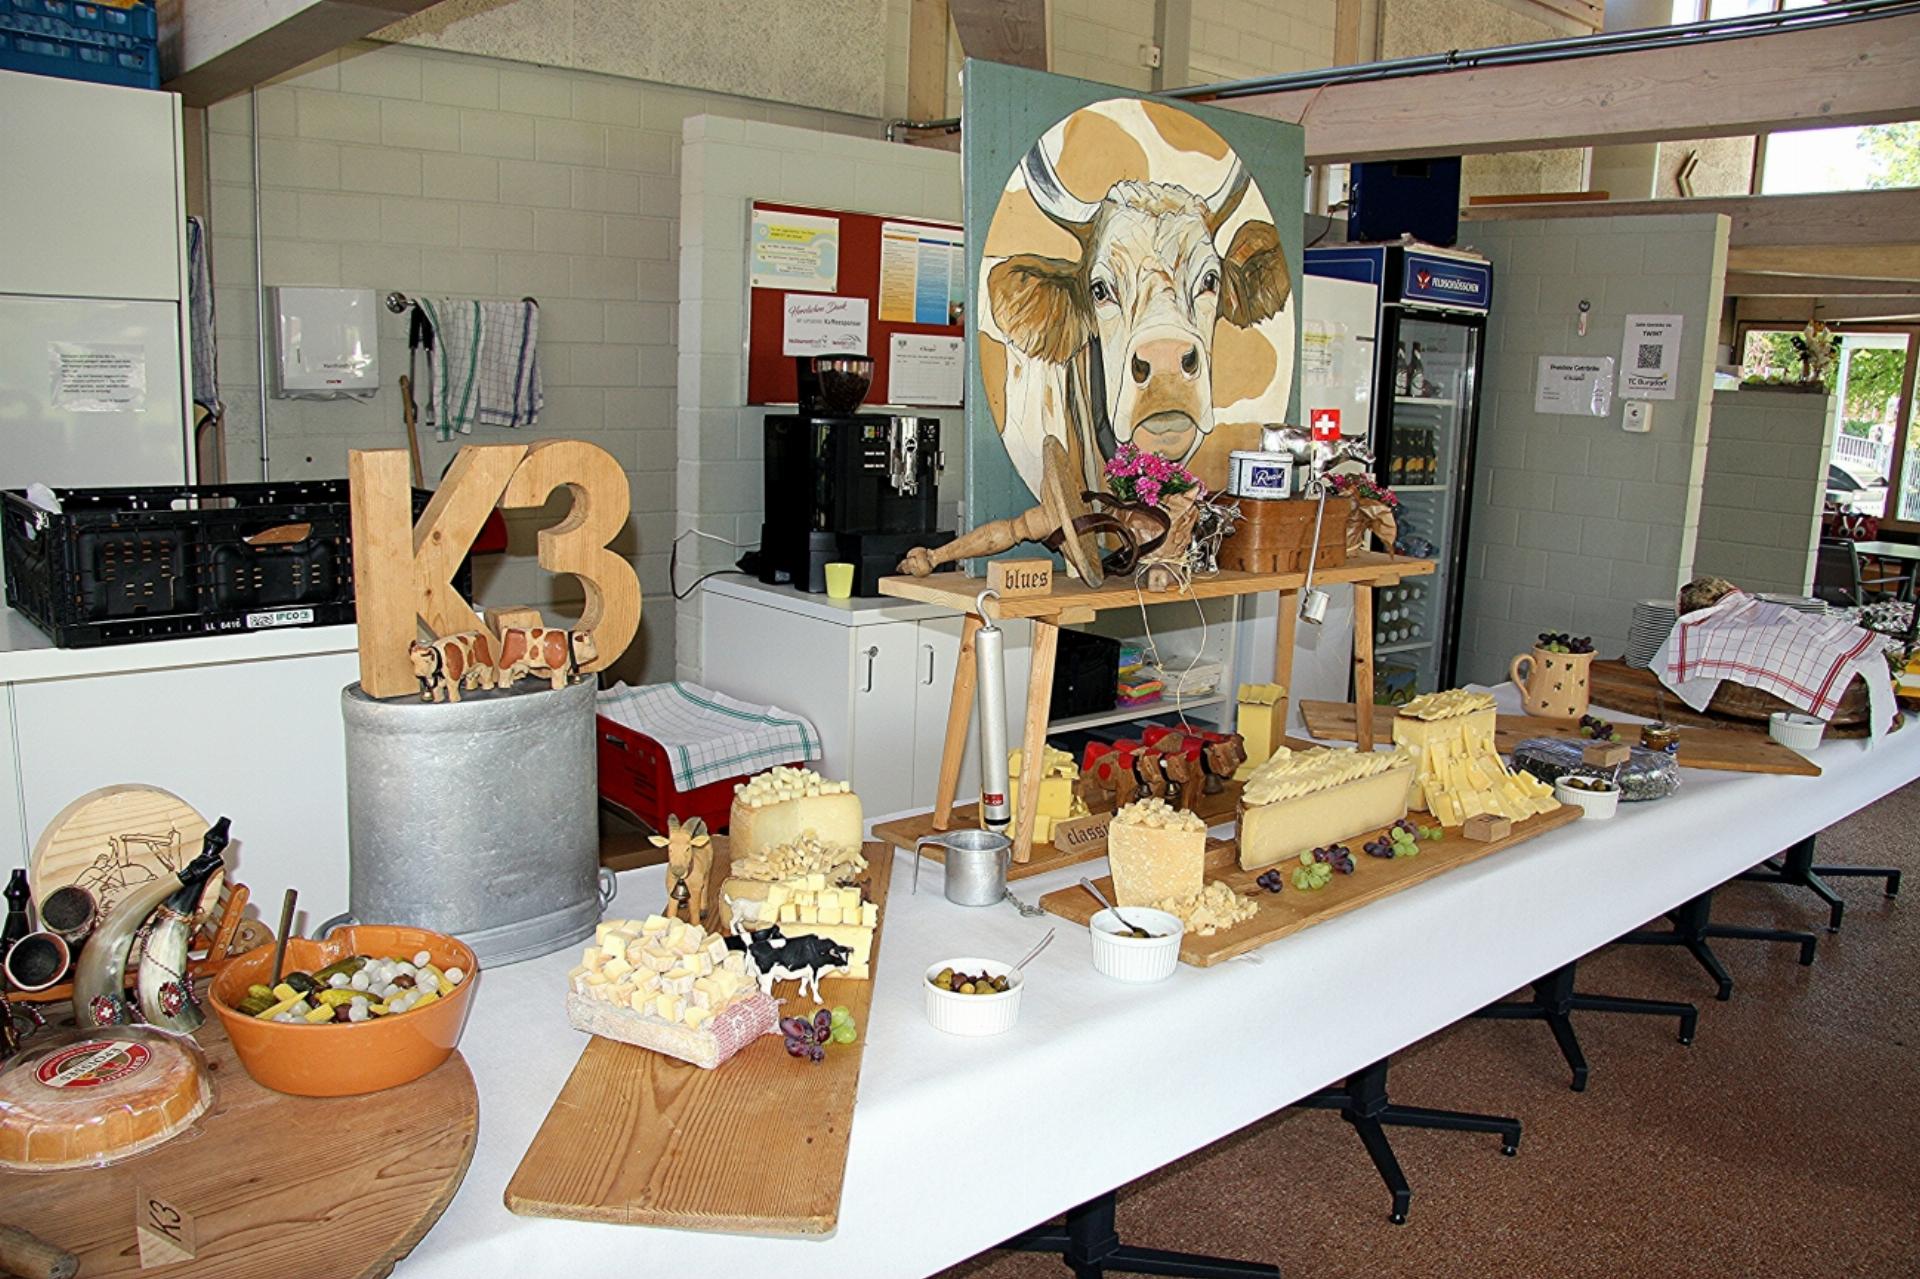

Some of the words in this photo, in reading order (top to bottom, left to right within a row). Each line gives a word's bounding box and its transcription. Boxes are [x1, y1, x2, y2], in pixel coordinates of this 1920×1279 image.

[349, 439, 642, 699] K3
[1005, 569, 1048, 590] blues
[276, 611, 300, 621] IFCO
[1067, 822, 1109, 846] classi
[148, 1199, 182, 1243] K3
